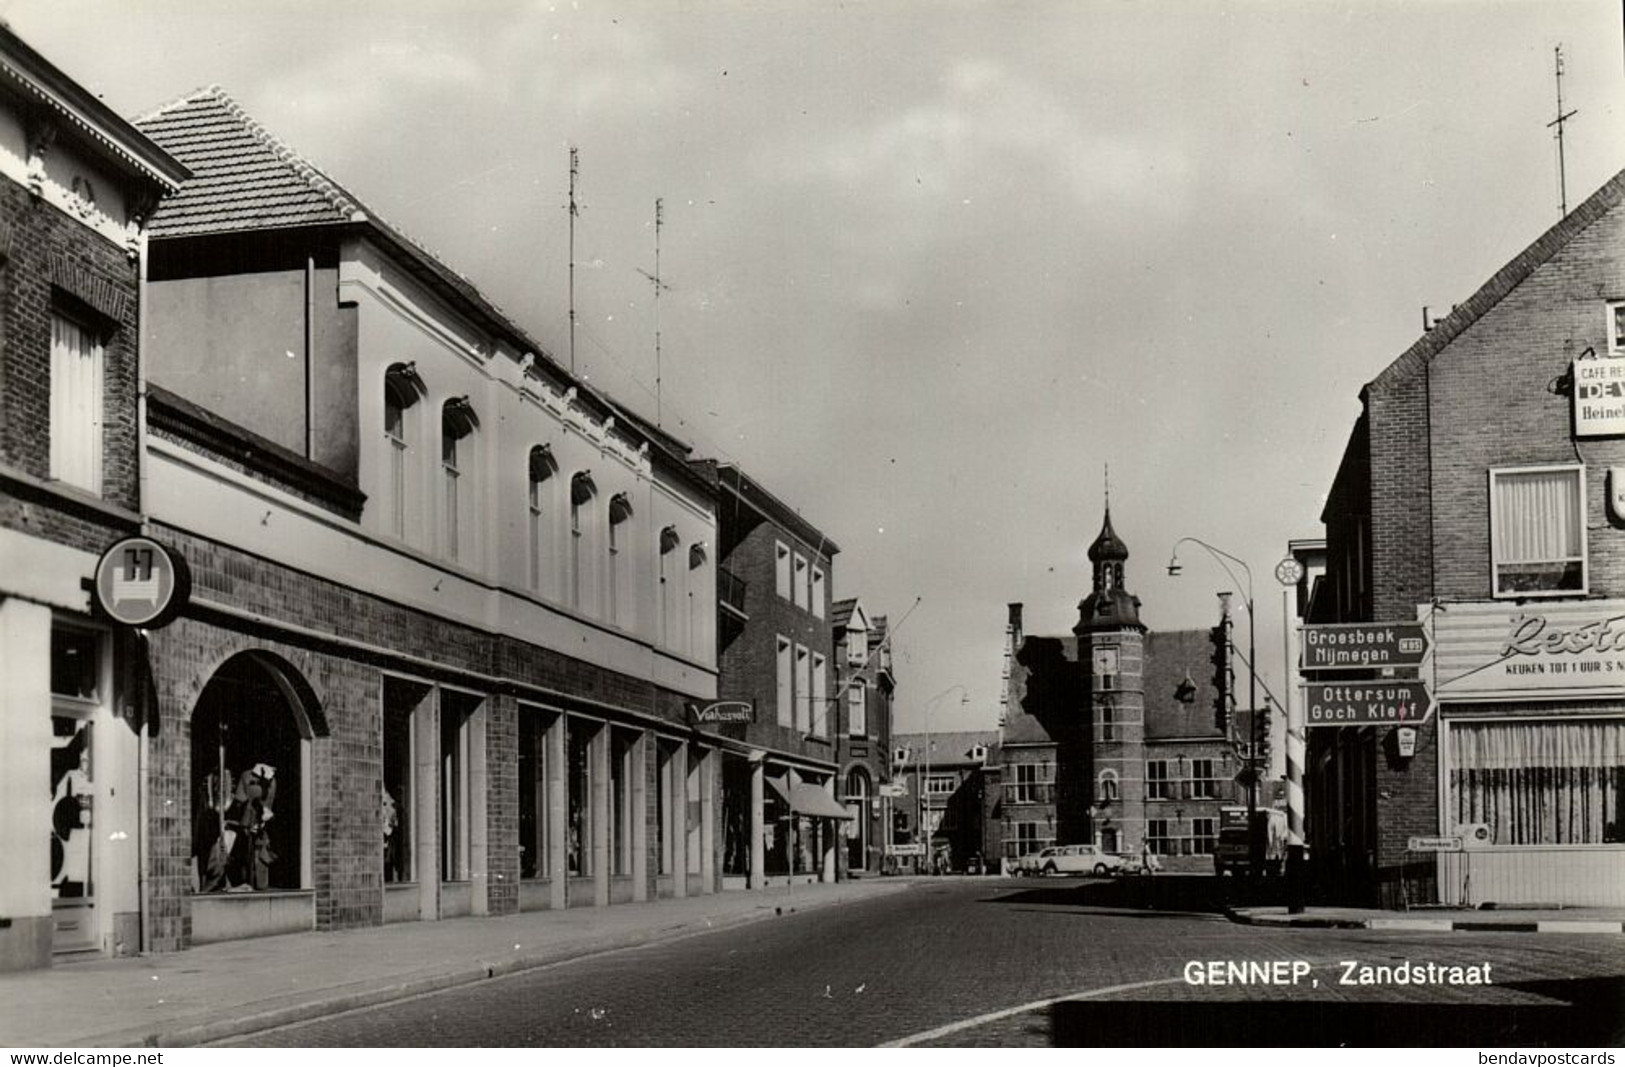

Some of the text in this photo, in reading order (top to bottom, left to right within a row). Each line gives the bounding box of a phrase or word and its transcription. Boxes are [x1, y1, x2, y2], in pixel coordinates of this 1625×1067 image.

[1308, 629, 1394, 645] Groesbeek
[1315, 648, 1389, 666] Nijmegen
[1506, 663, 1545, 675] KEUKEN
[1550, 662, 1568, 674] TOT
[1580, 661, 1601, 673] UUR
[1323, 686, 1412, 702] Ottersum
[1312, 702, 1416, 719] Goch Kleef
